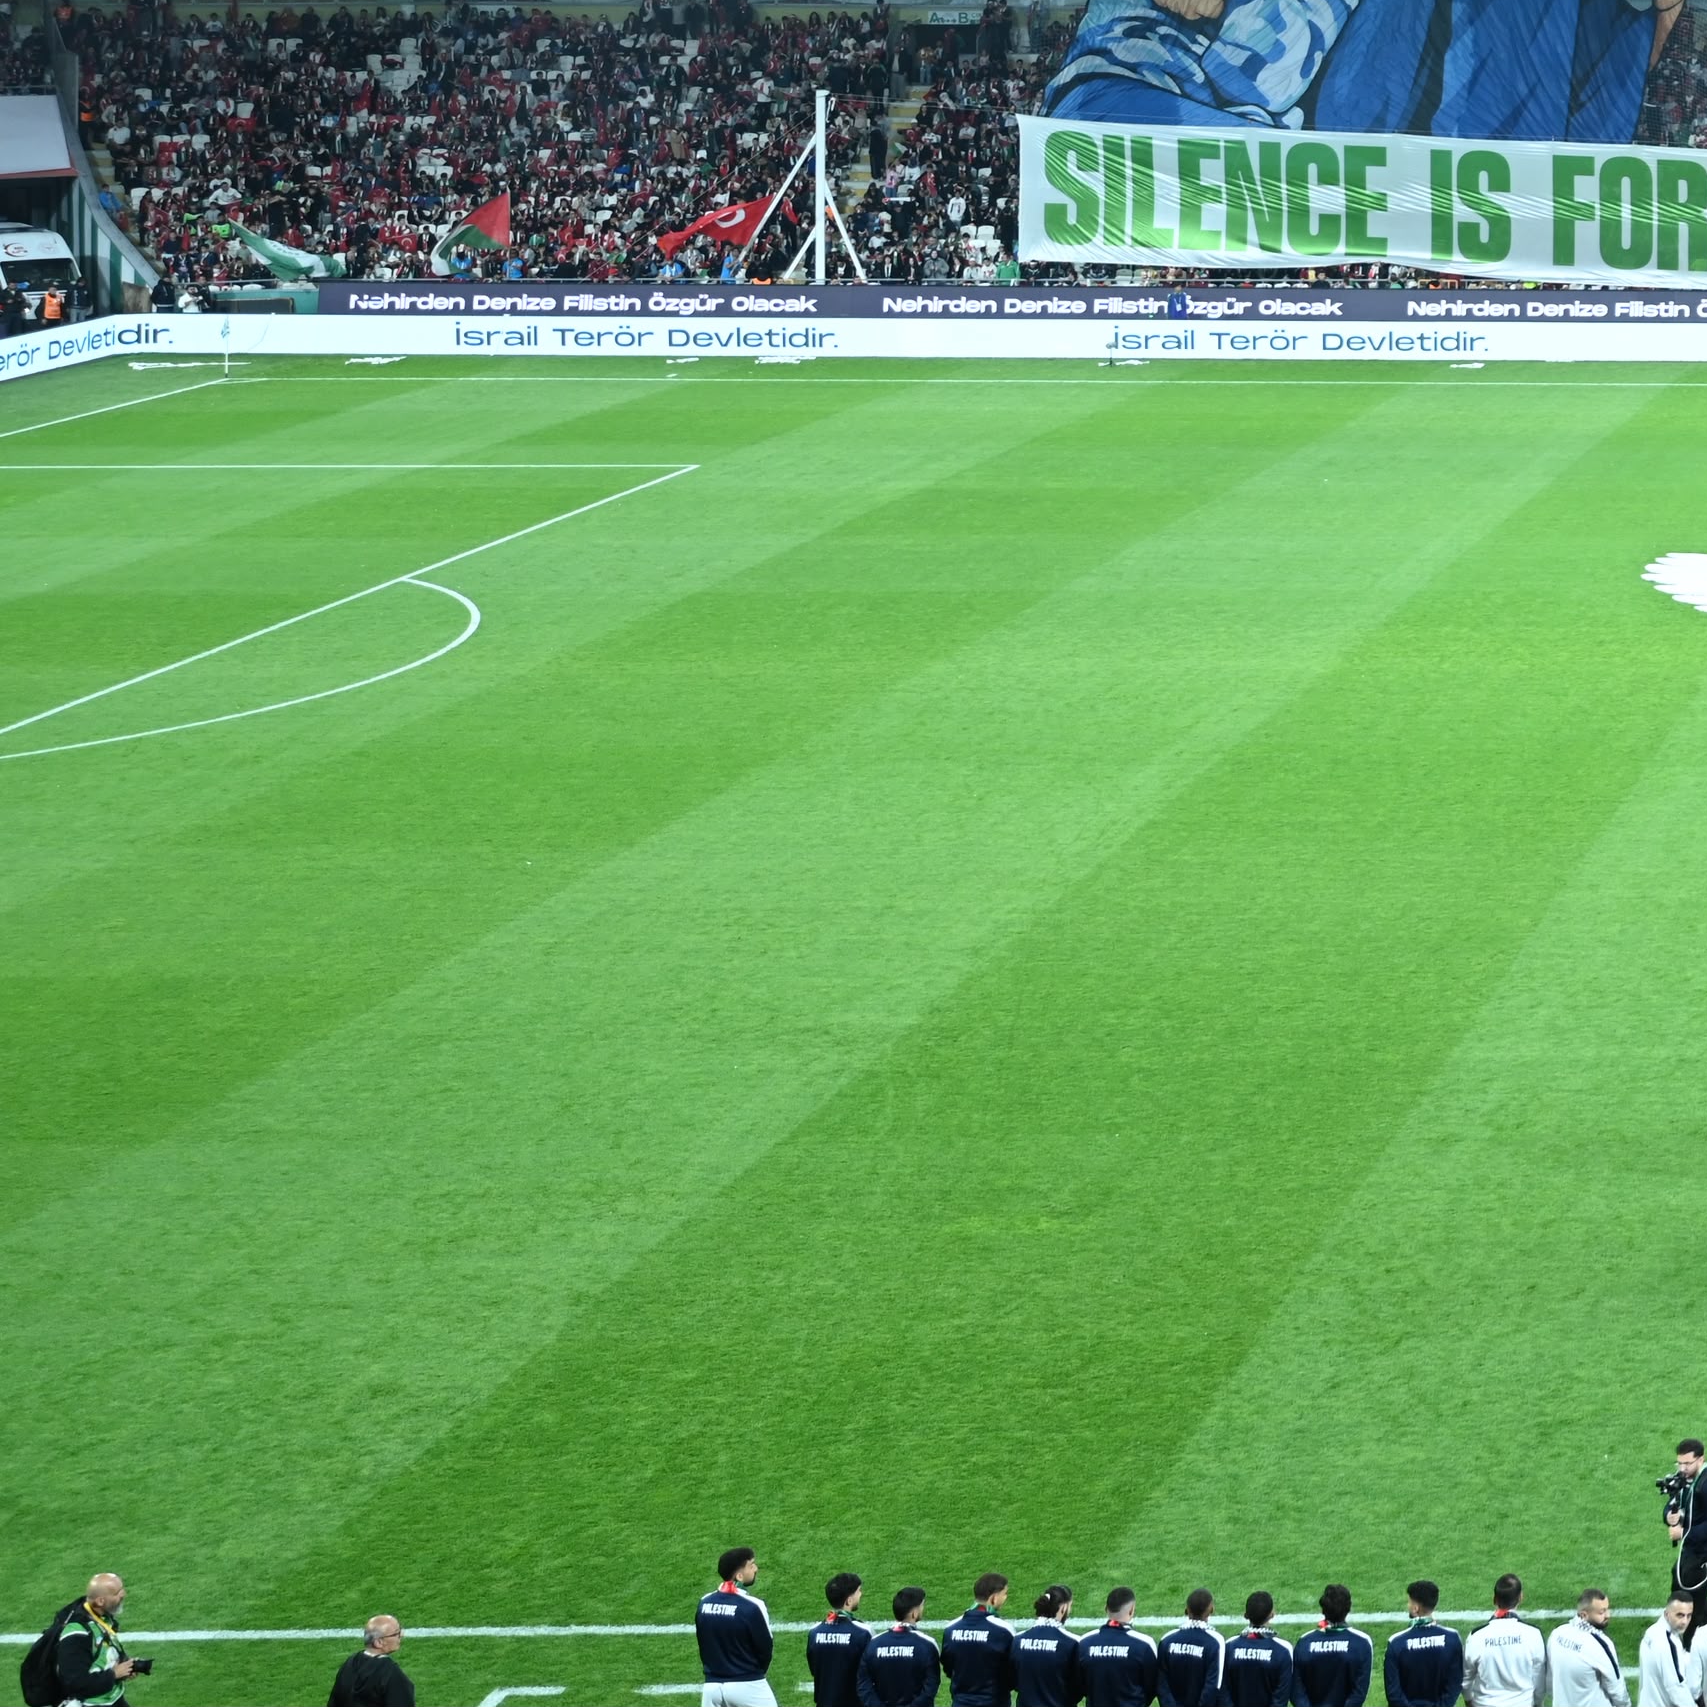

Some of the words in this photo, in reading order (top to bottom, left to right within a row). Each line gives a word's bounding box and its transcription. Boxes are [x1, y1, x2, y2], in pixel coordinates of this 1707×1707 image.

[1042, 126, 1389, 257] SILENCE
[1429, 148, 1512, 265] IS
[349, 292, 466, 310] Nehirden
[472, 293, 557, 311] Denize
[563, 294, 642, 311] Filistin
[648, 292, 725, 315] Özgür
[731, 295, 817, 312] Olacak
[882, 296, 997, 313] Nehirden
[1004, 297, 1087, 314] Denize
[1093, 297, 1169, 314] Filistin
[1258, 298, 1343, 316] Olacak
[1407, 299, 1521, 317] Nehirden
[1526, 300, 1609, 317] Denize
[1614, 300, 1691, 318] Filistin
[48, 323, 174, 360] Devletidir.
[552, 325, 654, 347] Terör
[668, 327, 838, 348] Devletidir.
[1209, 329, 1307, 351] Terör
[1322, 331, 1488, 352] Devletidir.
[701, 1603, 738, 1616] PALESTINE
[816, 1633, 852, 1645] PALESTINE
[952, 1629, 990, 1643] PALESTINE
[1406, 1635, 1447, 1651] PALESTINE
[1484, 1635, 1522, 1647] PALESTINE
[877, 1646, 915, 1658] PALESTINE
[1020, 1638, 1059, 1652] PALESTINE
[1089, 1645, 1130, 1658] PALESTINE
[1169, 1642, 1205, 1659] PALESTINE
[1309, 1640, 1350, 1654] PALESTINE
[1234, 1647, 1273, 1662] PALESTINE
